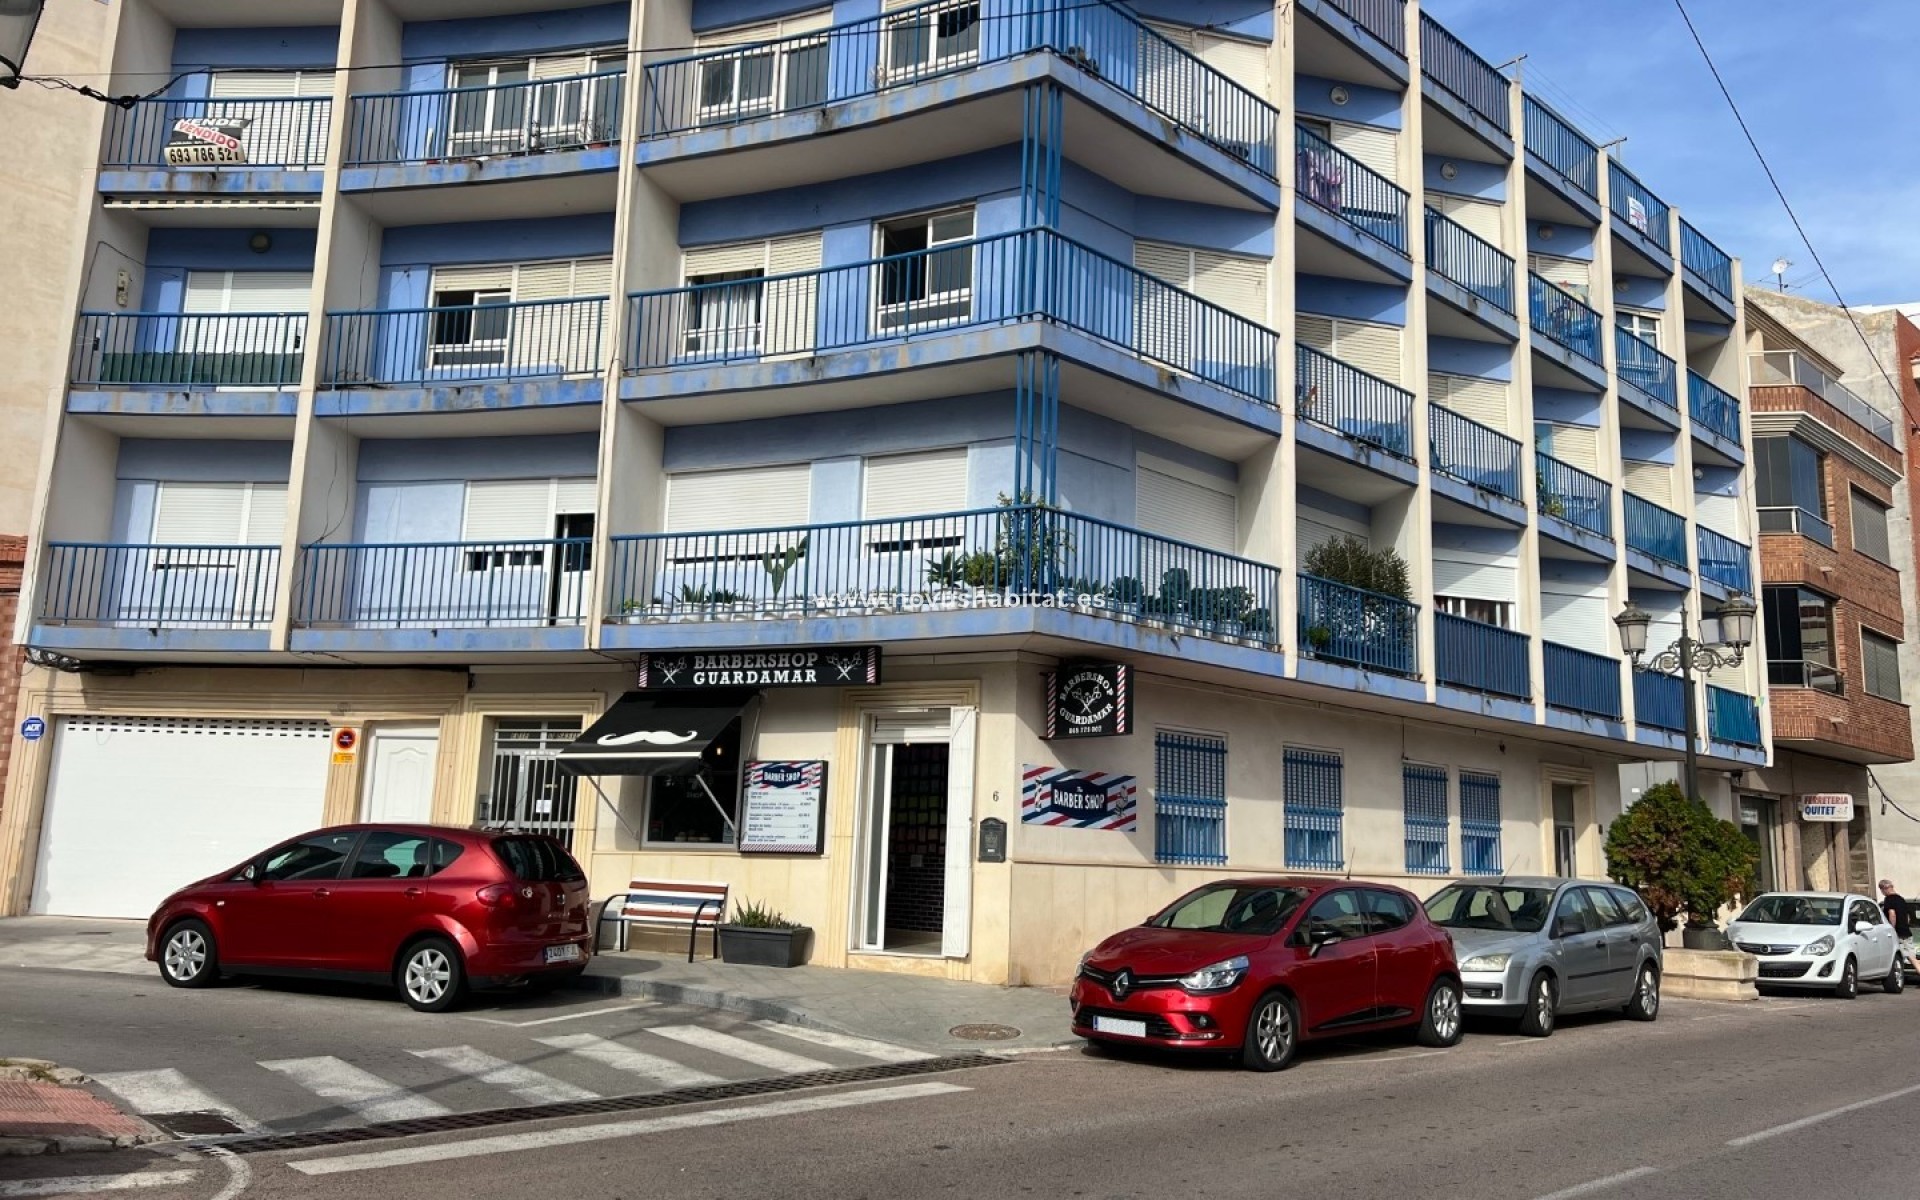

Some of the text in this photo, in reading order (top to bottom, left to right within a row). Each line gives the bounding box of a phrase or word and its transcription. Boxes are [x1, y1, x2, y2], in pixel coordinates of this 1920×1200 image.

[179, 121, 238, 149] VENDIDO
[169, 148, 191, 163] 693
[193, 147, 215, 162] 786
[694, 653, 818, 669] BARBERSHOP
[693, 669, 817, 685] GUARDAMAR
[1060, 672, 1114, 701] BARBERSHOP
[1060, 703, 1114, 725] GUARDAMAR
[992, 790, 1000, 802] 6
[1053, 788, 1105, 809] BARBER SHOP
[1804, 806, 1835, 815] QUITET
